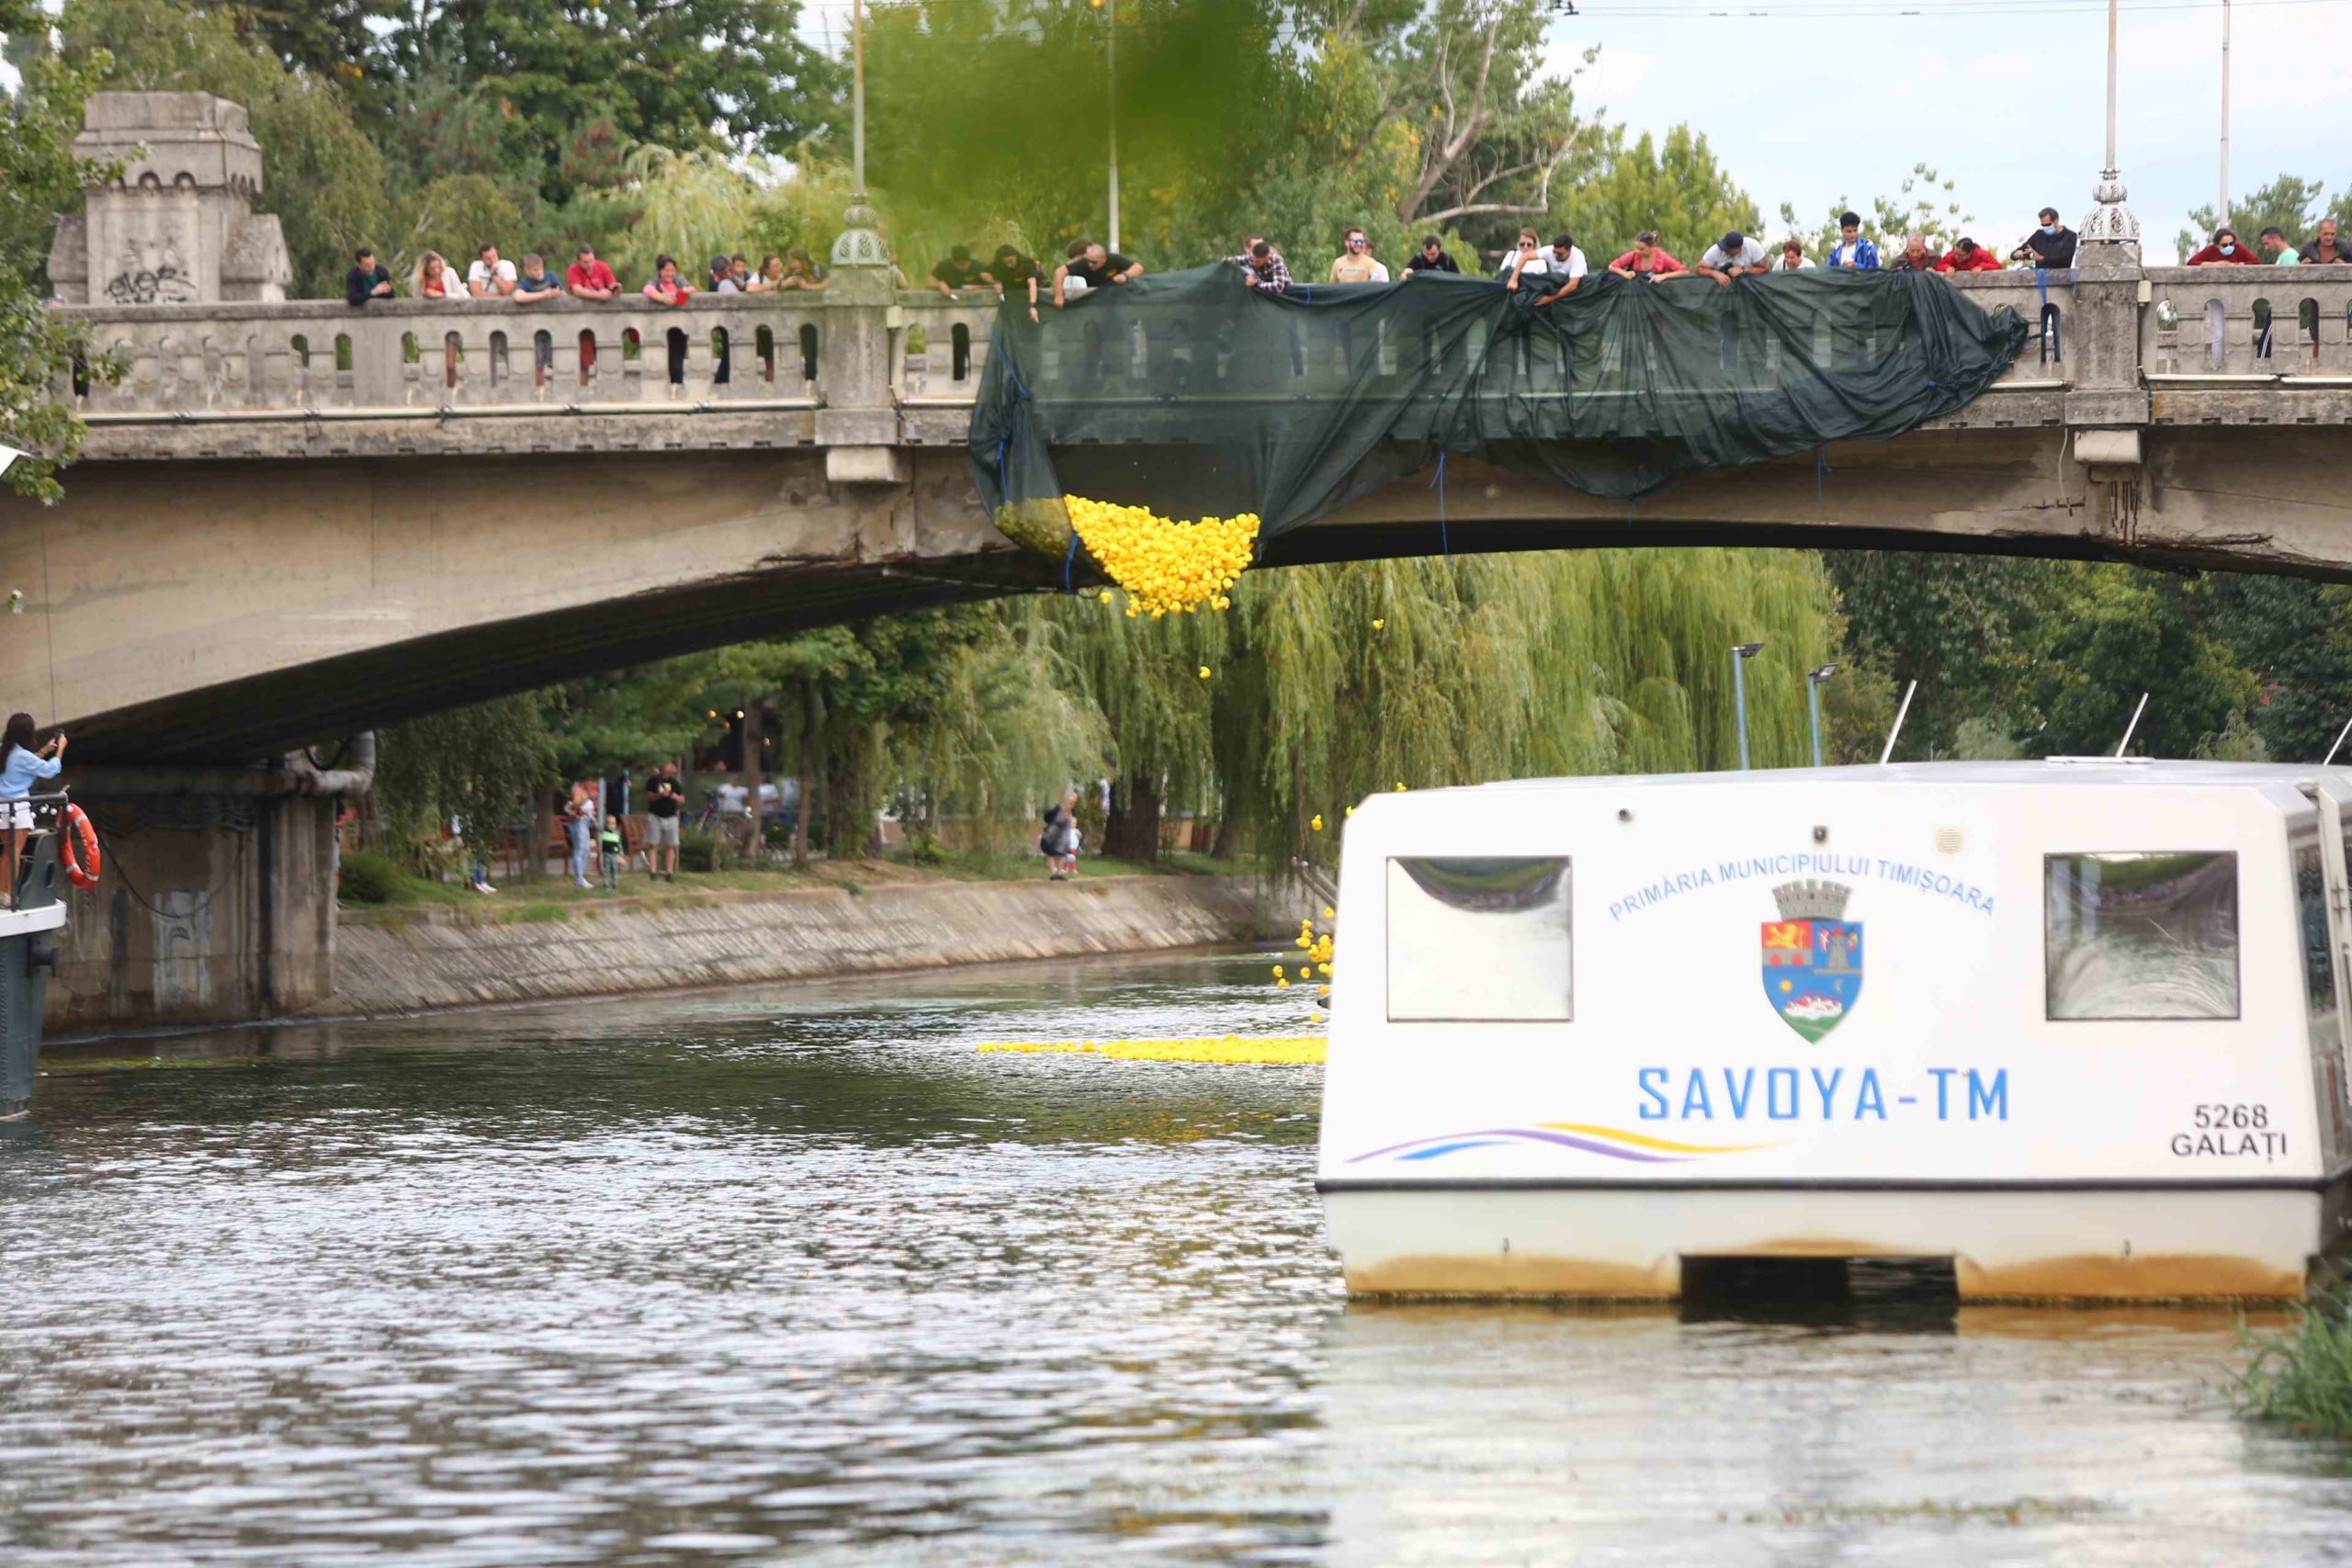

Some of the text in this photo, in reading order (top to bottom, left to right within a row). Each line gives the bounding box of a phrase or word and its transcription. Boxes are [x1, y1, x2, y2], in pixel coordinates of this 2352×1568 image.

[1609, 853, 1995, 920] PRIMĂRIA MUNICIPIULUI TIMIȘOARA
[1638, 1066, 2008, 1122] SAVOYA-TM
[2194, 1103, 2269, 1130] 5268
[2170, 1132, 2288, 1163] GALAȚI
